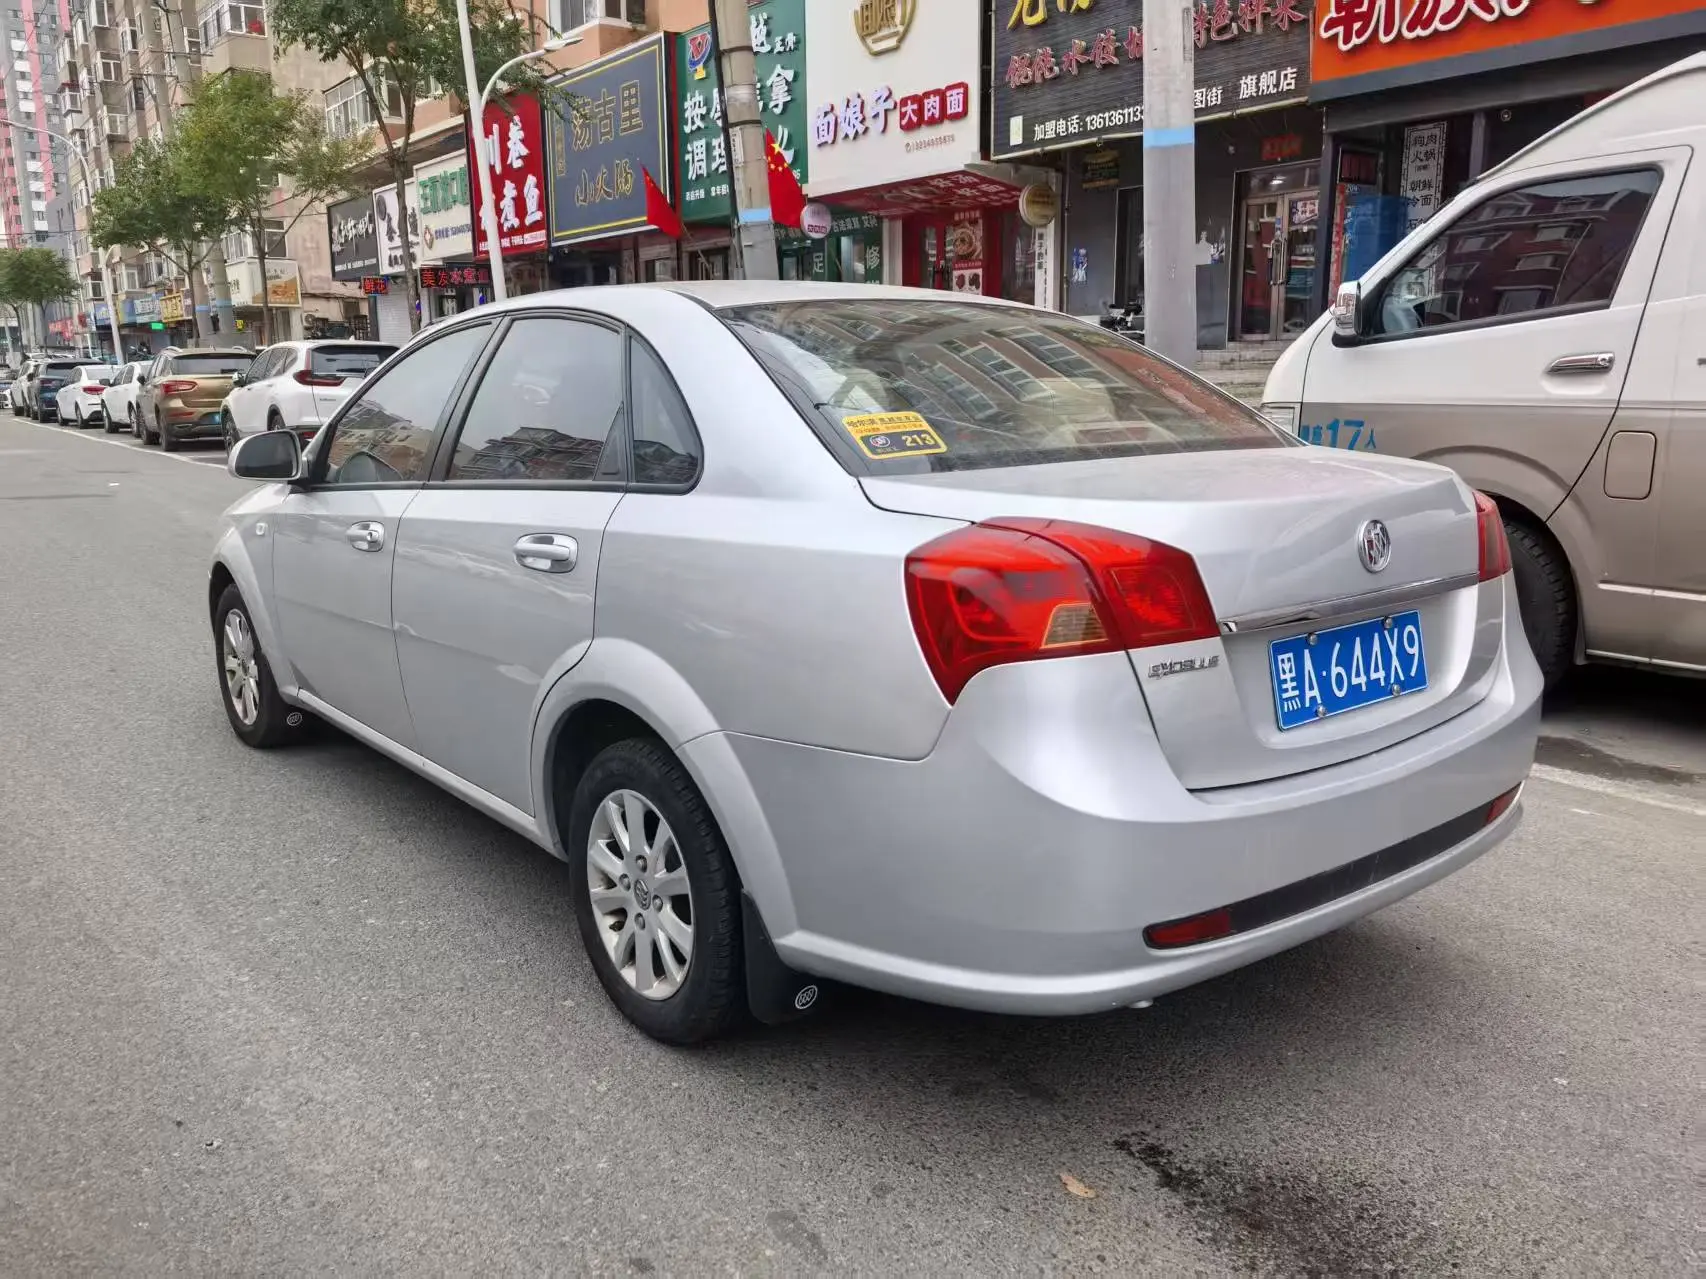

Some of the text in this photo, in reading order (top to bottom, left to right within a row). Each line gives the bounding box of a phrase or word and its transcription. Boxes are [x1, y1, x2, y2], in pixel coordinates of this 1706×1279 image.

[1239, 67, 1298, 100] 旗舰店
[815, 85, 964, 147] 面娘子 大肉面
[1410, 149, 1436, 163] 火锅
[1409, 179, 1434, 192] 朝鲜
[1407, 194, 1433, 207] 冷面
[902, 434, 935, 447] 213
[1277, 624, 1420, 713] 黑A·644X9
